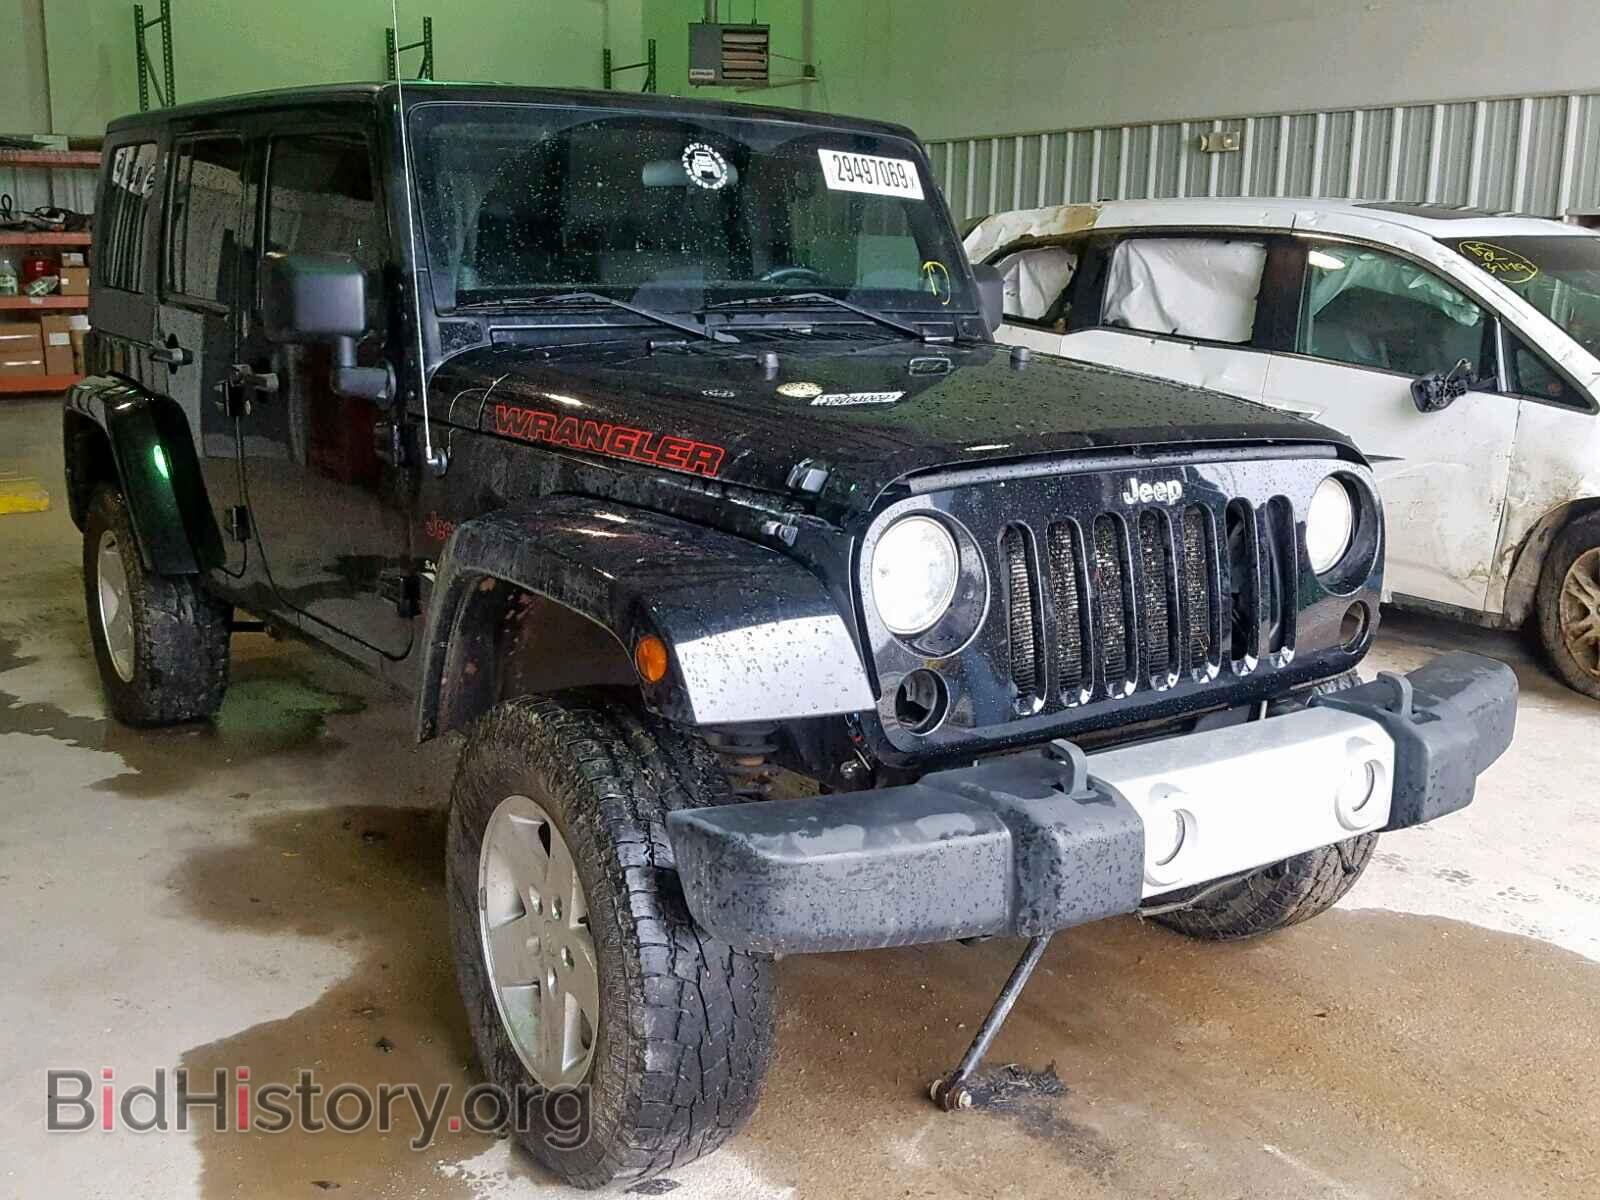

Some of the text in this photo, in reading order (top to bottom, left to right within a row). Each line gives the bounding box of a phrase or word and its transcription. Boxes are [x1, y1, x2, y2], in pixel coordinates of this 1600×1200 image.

[833, 154, 908, 189] 29497069
[495, 405, 725, 477] WRANGLER
[1122, 478, 1183, 506] Jeep
